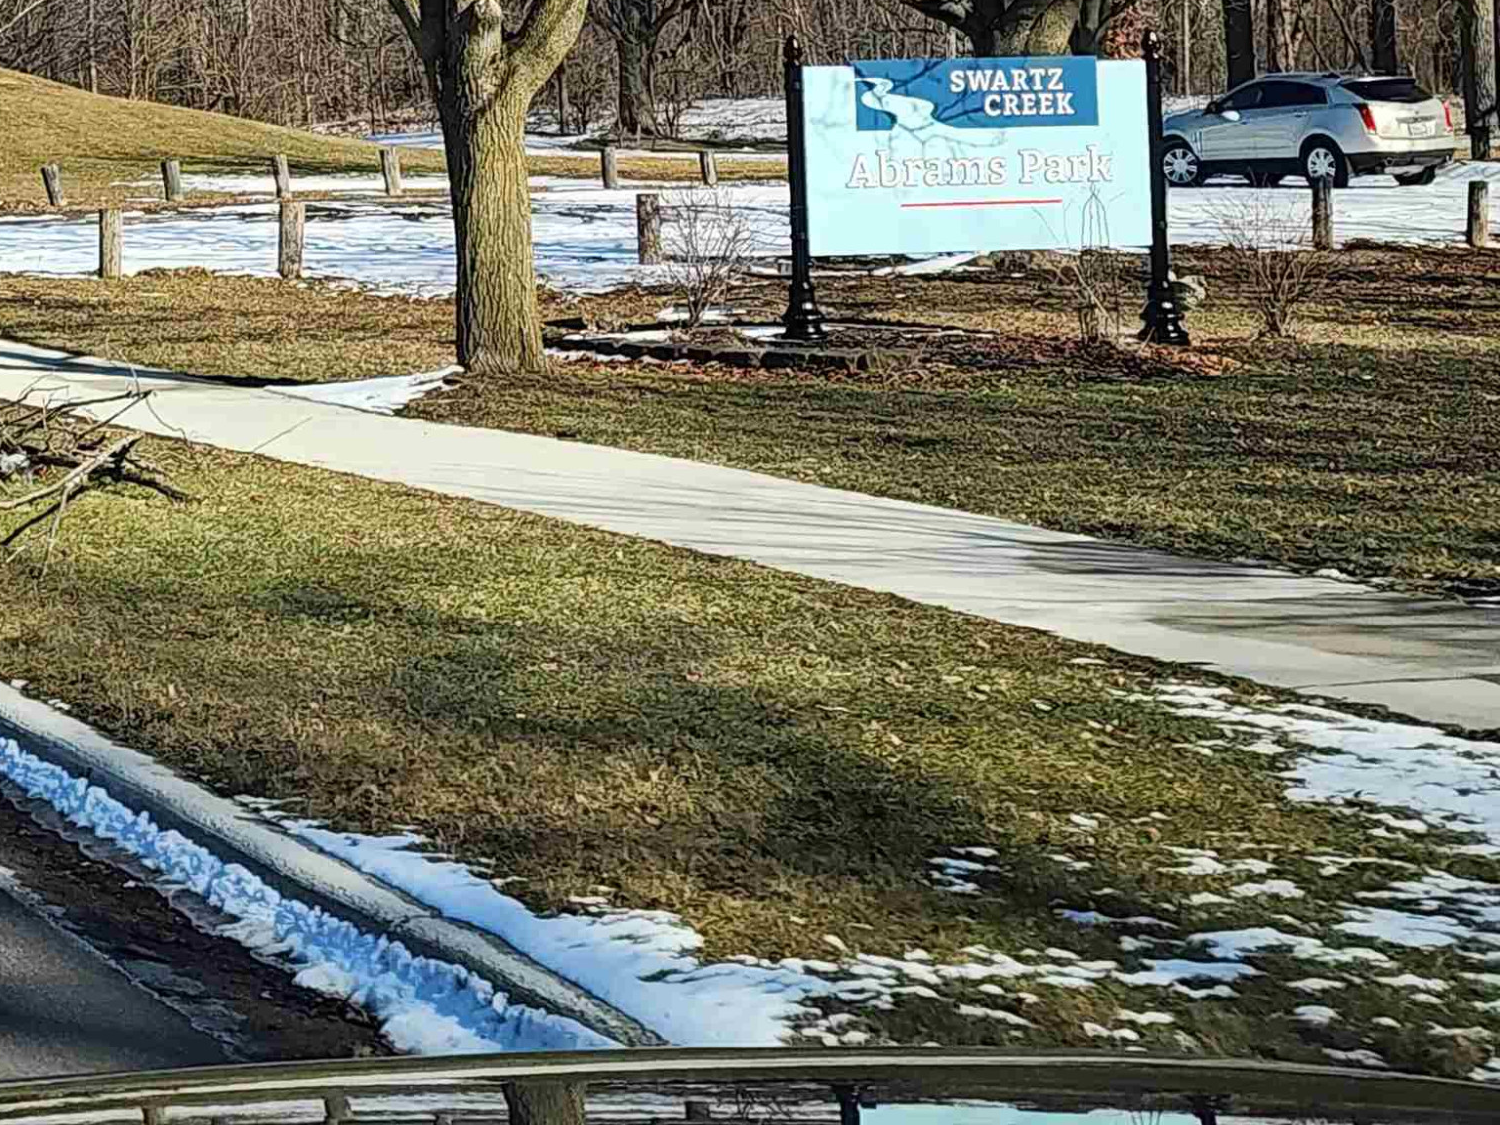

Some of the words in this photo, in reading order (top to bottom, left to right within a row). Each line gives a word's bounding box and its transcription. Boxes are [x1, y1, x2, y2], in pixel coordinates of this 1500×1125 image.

[949, 68, 1064, 93] SWARTZ
[984, 93, 1075, 117] CREEK
[846, 148, 1007, 189] Abrams
[1018, 145, 1113, 184] Park
